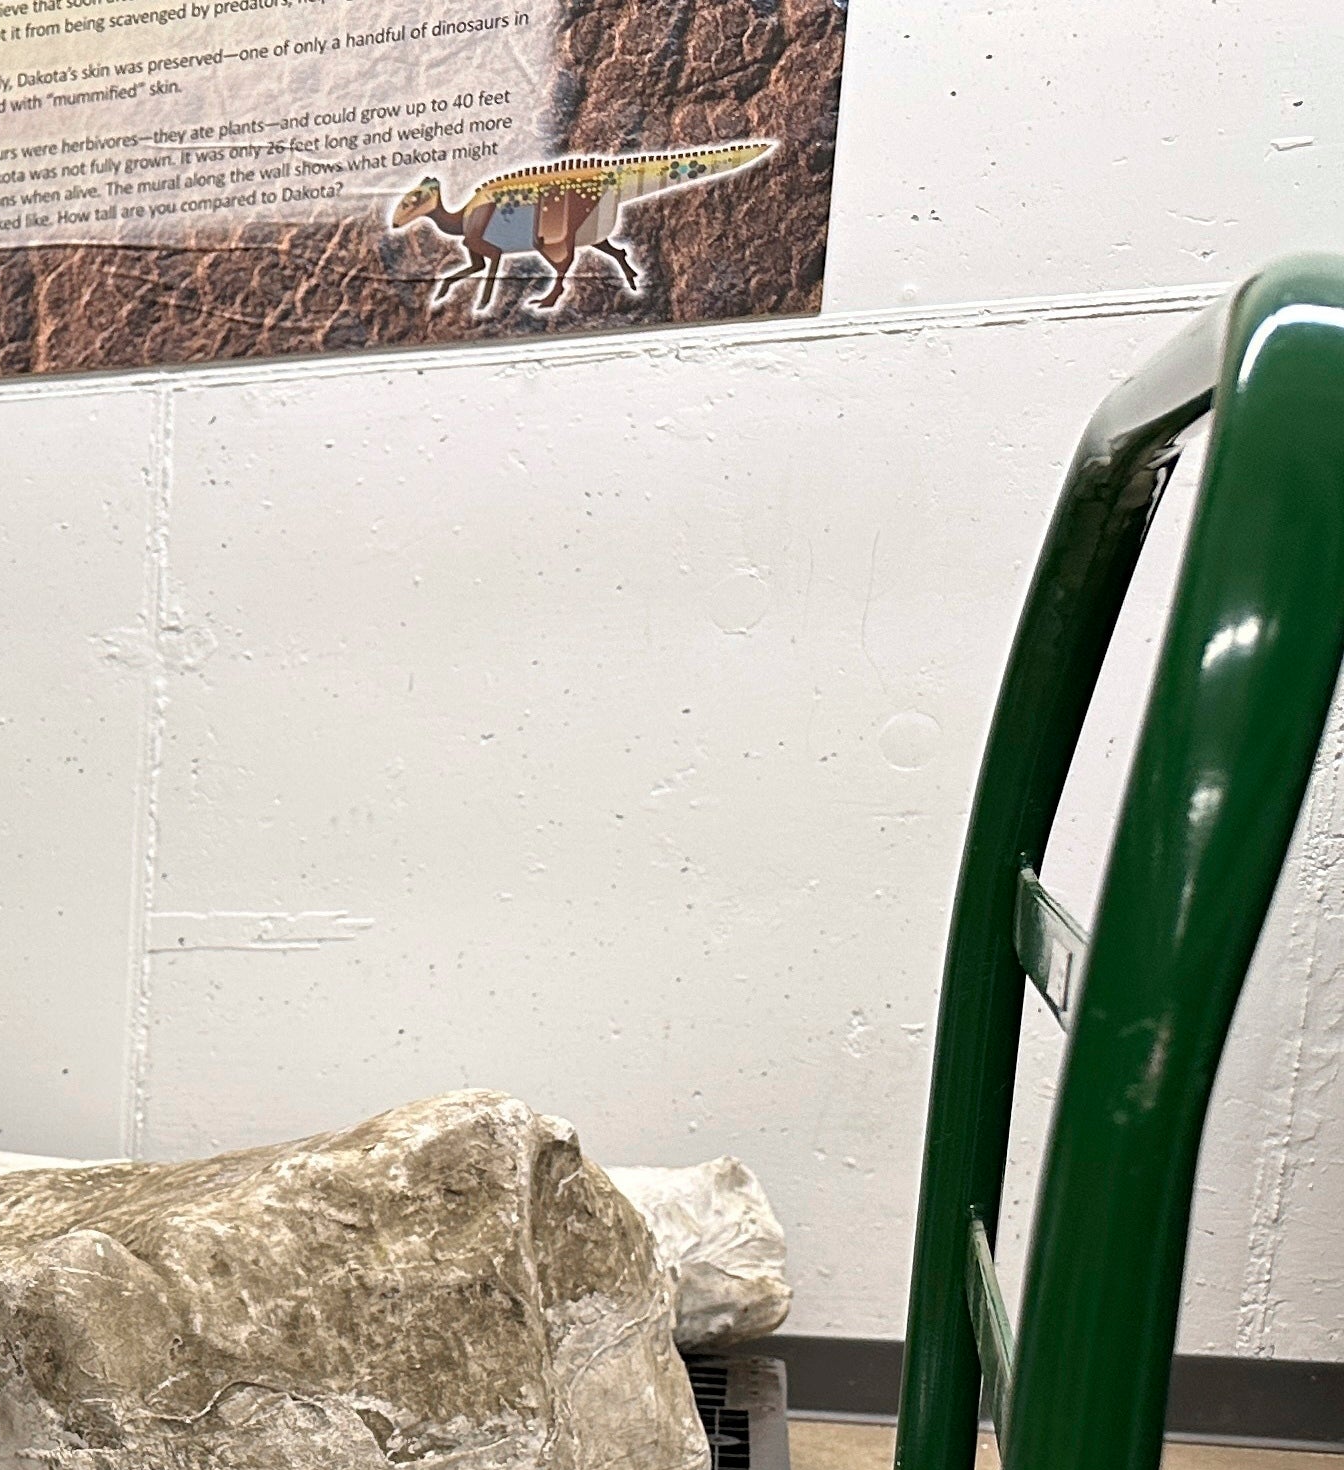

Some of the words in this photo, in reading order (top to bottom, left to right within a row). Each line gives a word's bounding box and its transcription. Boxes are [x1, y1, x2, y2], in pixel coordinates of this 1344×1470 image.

[11, 26, 21, 40] it
[25, 22, 60, 39] from
[64, 16, 105, 33] being
[109, 5, 186, 28] scavenged
[191, 3, 209, 19] by
[33, 0, 62, 13] that
[17, 66, 77, 88] Dakota's
[81, 62, 110, 78] skin
[114, 60, 143, 75] was
[273, 40, 290, 57] of
[294, 37, 327, 55] only
[331, 37, 341, 50] a
[346, 25, 406, 48] handful
[410, 22, 428, 39] of
[431, 15, 509, 37] dinosaurs
[514, 10, 529, 26] in
[10, 94, 42, 112] with
[149, 80, 182, 97] skin.
[21, 142, 58, 158] were
[190, 126, 214, 141] ate
[314, 107, 356, 126] could
[360, 104, 401, 124] grow
[405, 101, 426, 117] up
[431, 98, 448, 113] to
[452, 93, 474, 109] 40
[478, 89, 511, 106] feet
[20, 189, 61, 206] when
[65, 184, 102, 201] alive.
[106, 180, 133, 196] The
[137, 174, 180, 193] mural
[184, 172, 226, 188] along
[230, 167, 255, 183] the
[259, 162, 290, 180] wall
[294, 160, 343, 177] shows
[347, 154, 387, 171] what
[392, 148, 447, 167] Dakota
[452, 140, 499, 161] might
[29, 166, 58, 181] was
[61, 161, 86, 177] not
[90, 157, 122, 175] fully
[124, 153, 176, 175] grown.
[180, 150, 191, 165] It
[195, 147, 225, 163] was
[229, 143, 261, 160] only
[266, 139, 285, 156] 26
[289, 136, 320, 152] feet
[324, 133, 359, 150] long
[362, 128, 392, 146] and
[397, 119, 464, 142] weighed
[469, 116, 513, 133] more
[25, 212, 54, 228] like.
[57, 209, 90, 224] How
[94, 205, 117, 221] tall
[120, 204, 145, 219] are
[149, 201, 176, 219] you
[180, 191, 257, 213] compared
[261, 188, 276, 204] to
[281, 181, 344, 202] Dakota?
